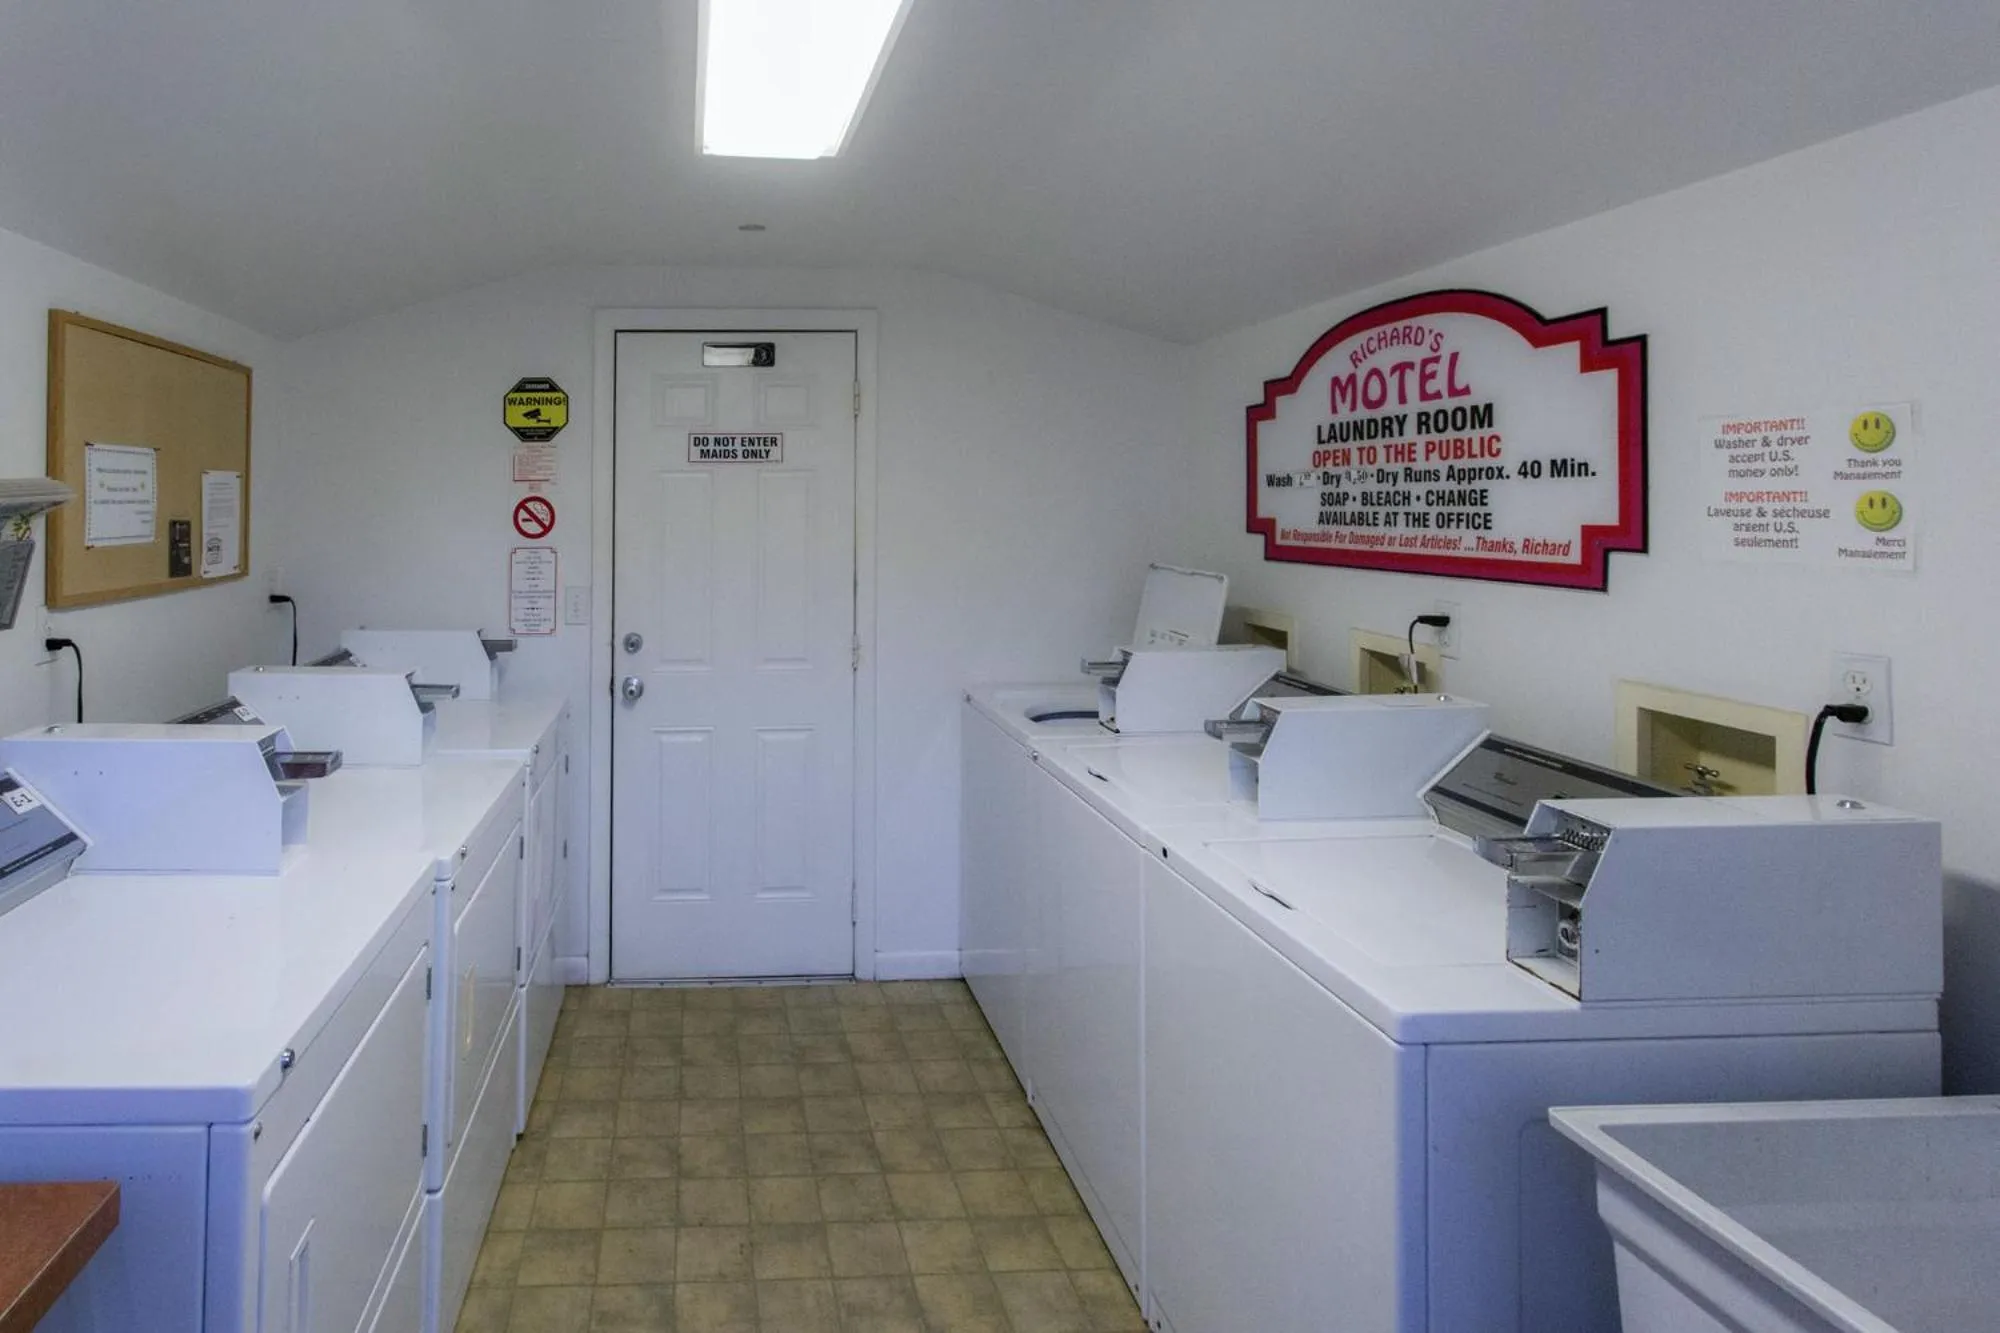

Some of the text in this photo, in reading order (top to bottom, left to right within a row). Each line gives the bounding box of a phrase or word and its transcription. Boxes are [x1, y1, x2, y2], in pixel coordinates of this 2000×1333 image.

[1350, 325, 1444, 369] RICHARD'S
[1331, 351, 1471, 415] MOTEL
[507, 397, 567, 406] WARNING!
[1317, 403, 1493, 444] LAUNDRY ROOM
[1722, 418, 1806, 435] IMPORTANT!!
[693, 437, 778, 447] DO NOT ENTER
[1714, 435, 1810, 449] Washer & dryer
[700, 449, 771, 459] MAIDS ONLY
[1312, 435, 1501, 468] OPEN TO THE PUBLIC
[1728, 450, 1794, 464] accept U.S.
[1846, 458, 1902, 469] Thank you
[1266, 473, 1293, 487] Wash
[1322, 471, 1341, 488] Dry
[1377, 468, 1399, 486] Dry
[1404, 467, 1440, 483] Runs
[1446, 464, 1510, 485] Approx.
[1518, 460, 1542, 479] 40
[1550, 458, 1596, 478] Min.
[1728, 465, 1799, 479] money only!
[1320, 488, 1488, 507] SOAP BLEACH CHANGE
[1724, 491, 1808, 502] IMPORTANT!!
[1707, 506, 1752, 518] Laveuse
[1756, 507, 1767, 518] &
[1318, 511, 1492, 530] AVAILABLE AT THE OFFICE
[1774, 521, 1800, 534] U.S.
[1293, 529, 1333, 544] Responsible
[1334, 531, 1347, 543] For
[1349, 531, 1386, 548] Damaged
[1387, 535, 1397, 546] or
[1399, 534, 1418, 548] Lost
[1420, 533, 1462, 551] Articles!
[1522, 537, 1572, 557] Richard
[1733, 536, 1799, 549] seulement!
